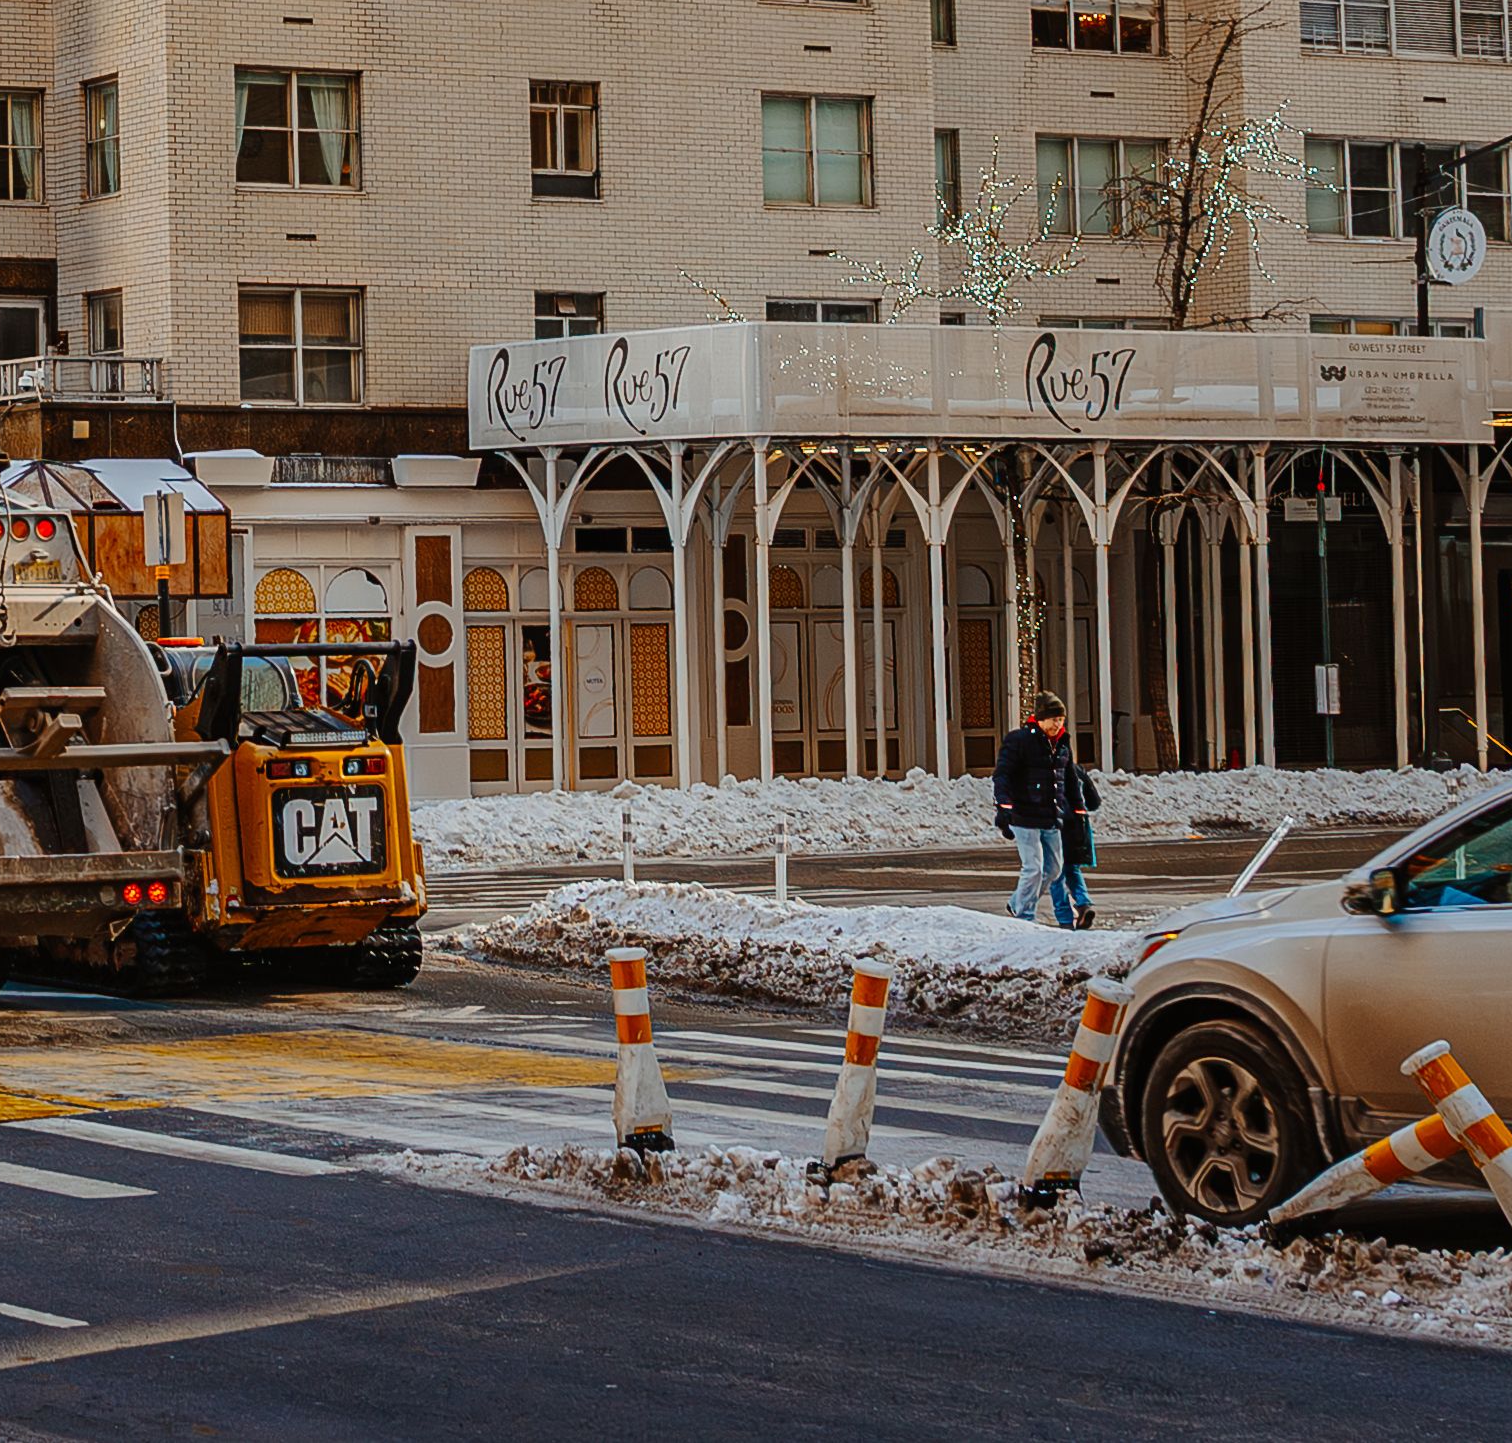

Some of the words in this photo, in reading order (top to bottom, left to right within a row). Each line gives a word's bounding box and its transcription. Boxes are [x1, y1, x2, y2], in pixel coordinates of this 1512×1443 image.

[1361, 344, 1384, 353] WEST
[1386, 344, 1396, 353] 57
[1397, 344, 1427, 354] STREET
[1349, 370, 1388, 378] URBAN
[1393, 371, 1454, 381] UMBRELLA
[283, 797, 378, 865] CAT
